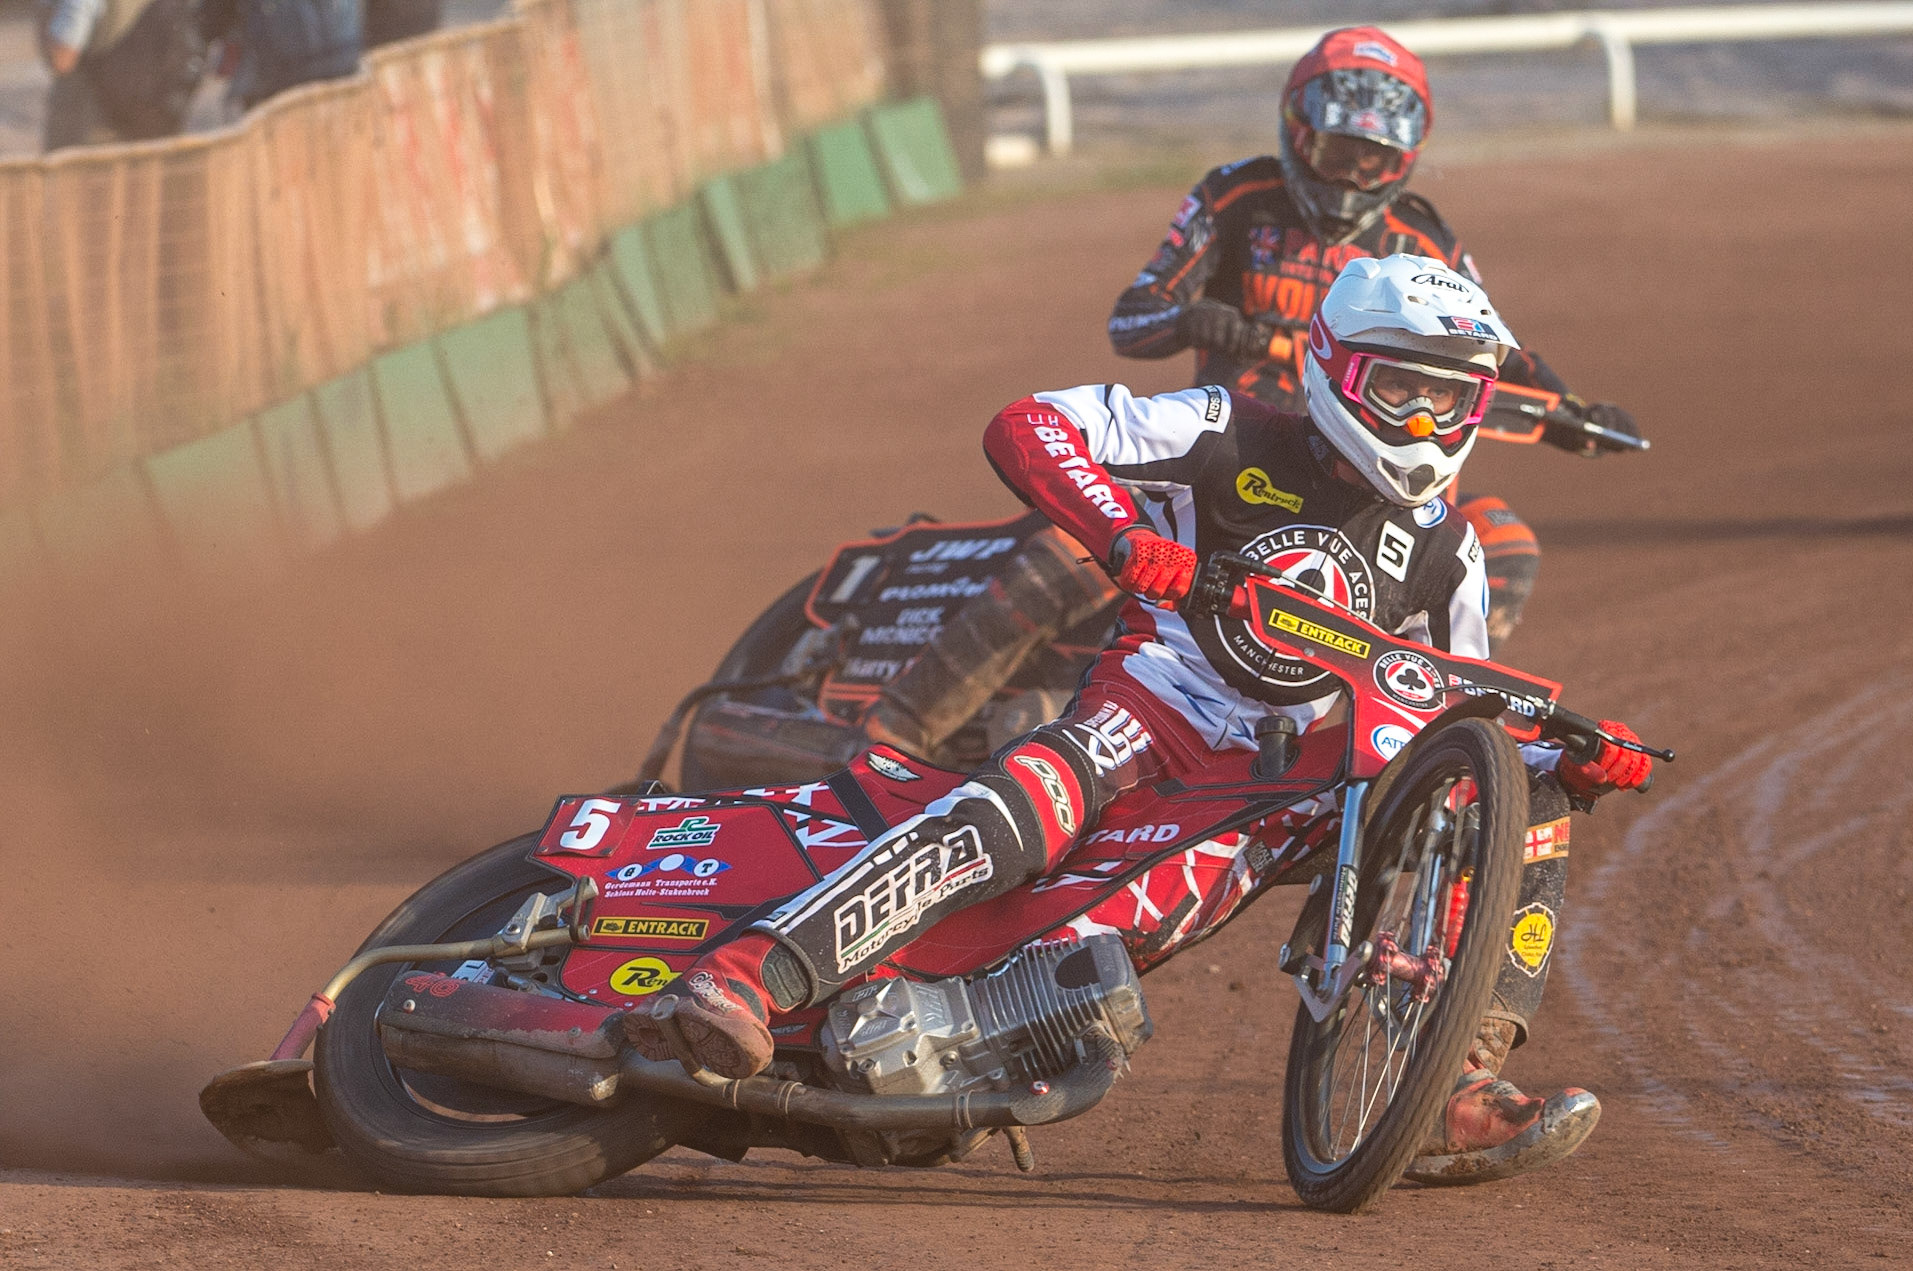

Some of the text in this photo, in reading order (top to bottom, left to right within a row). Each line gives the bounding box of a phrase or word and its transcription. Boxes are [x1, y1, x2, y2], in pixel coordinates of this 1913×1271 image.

[1411, 274, 1470, 292] Arai
[1034, 426, 1128, 520] BETARD
[1245, 530, 1305, 561] BELLE
[1318, 531, 1352, 565] VUE
[1381, 533, 1408, 568] 5
[831, 555, 881, 602] 1
[1300, 623, 1362, 653] ENTRACK
[1233, 634, 1304, 676] MANCHESTER
[1379, 653, 1402, 669] BELLE
[1405, 654, 1425, 667] VUE
[559, 799, 621, 850] 5
[652, 831, 714, 843] ROCK OIL
[623, 867, 637, 877] G
[701, 862, 713, 874] T
[605, 889, 634, 897] Schloss
[655, 879, 701, 887] Transporte
[838, 826, 981, 951] DEFRA
[627, 921, 699, 936] ENTRACK
